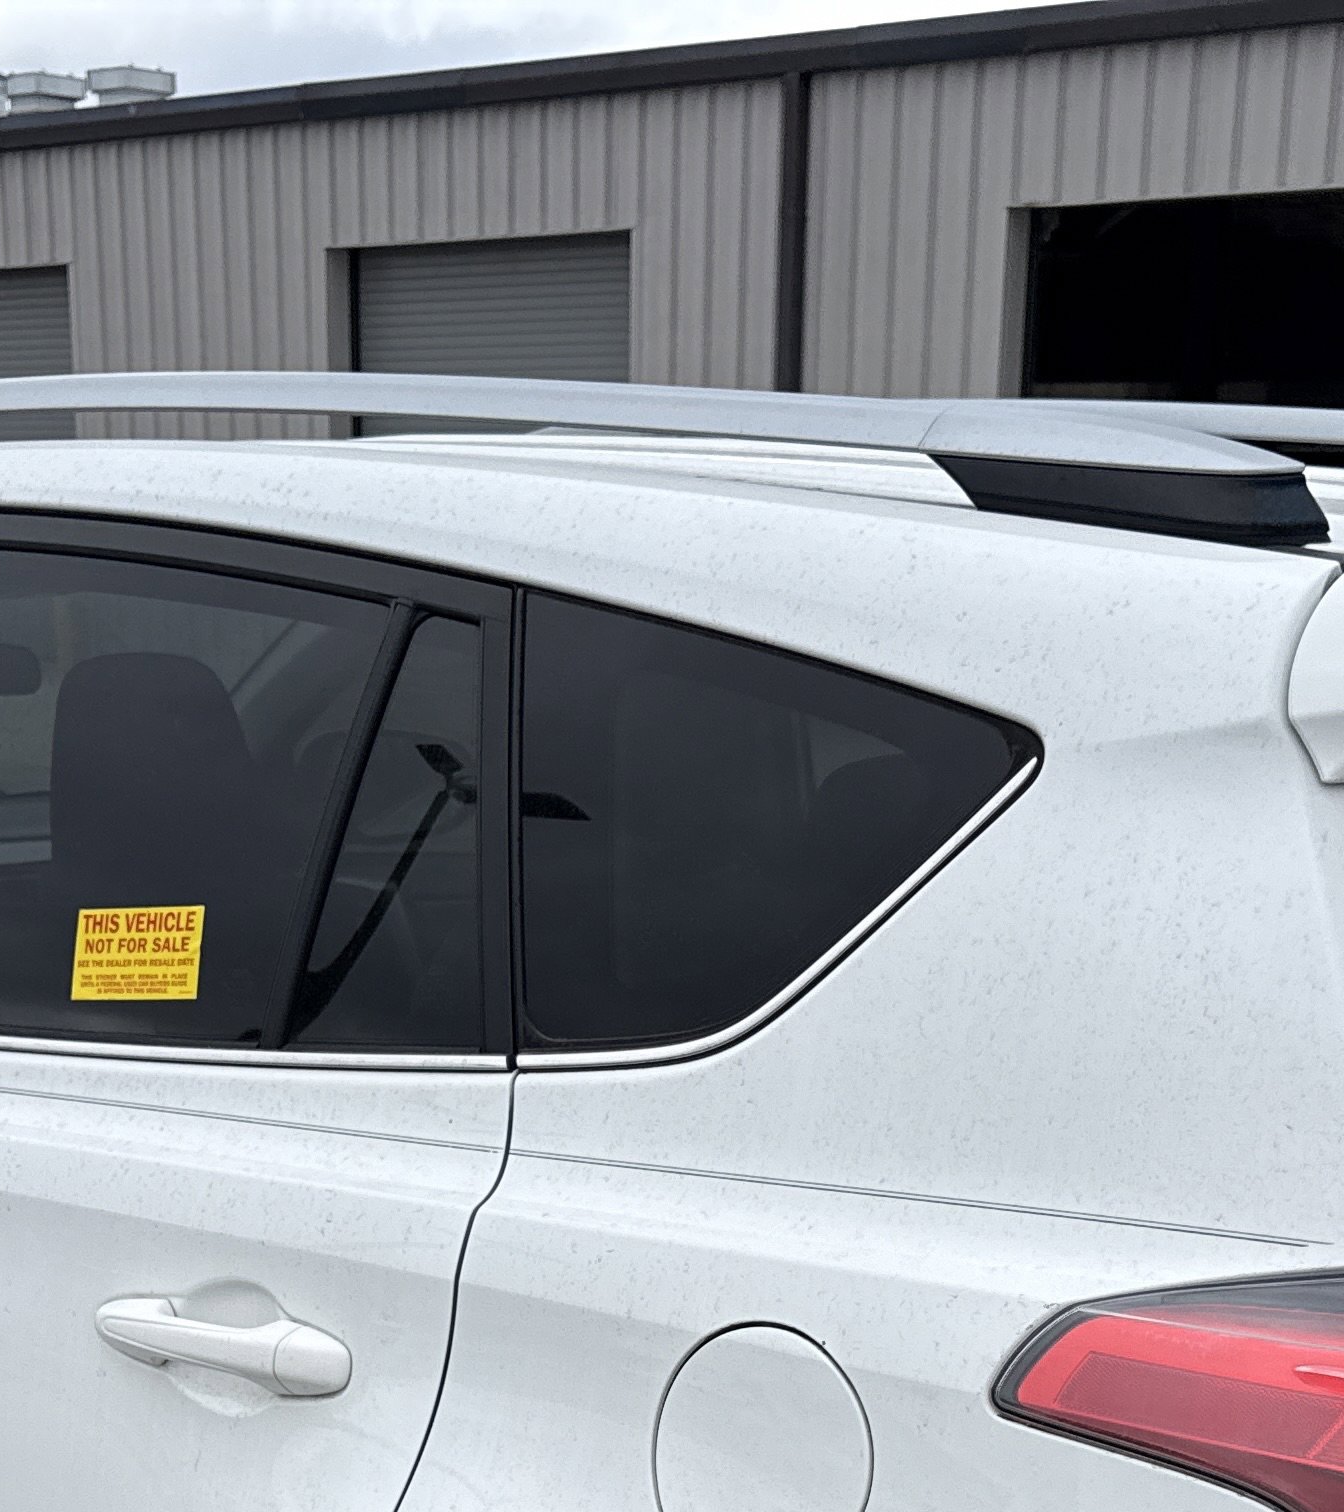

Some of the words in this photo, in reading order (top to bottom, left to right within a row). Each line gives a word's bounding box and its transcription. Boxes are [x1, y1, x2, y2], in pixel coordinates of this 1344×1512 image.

[83, 913, 120, 934] THIS
[125, 911, 196, 933] VEHICLE
[84, 938, 114, 954] NOT
[117, 938, 148, 953] FOR
[152, 936, 191, 953] SALE
